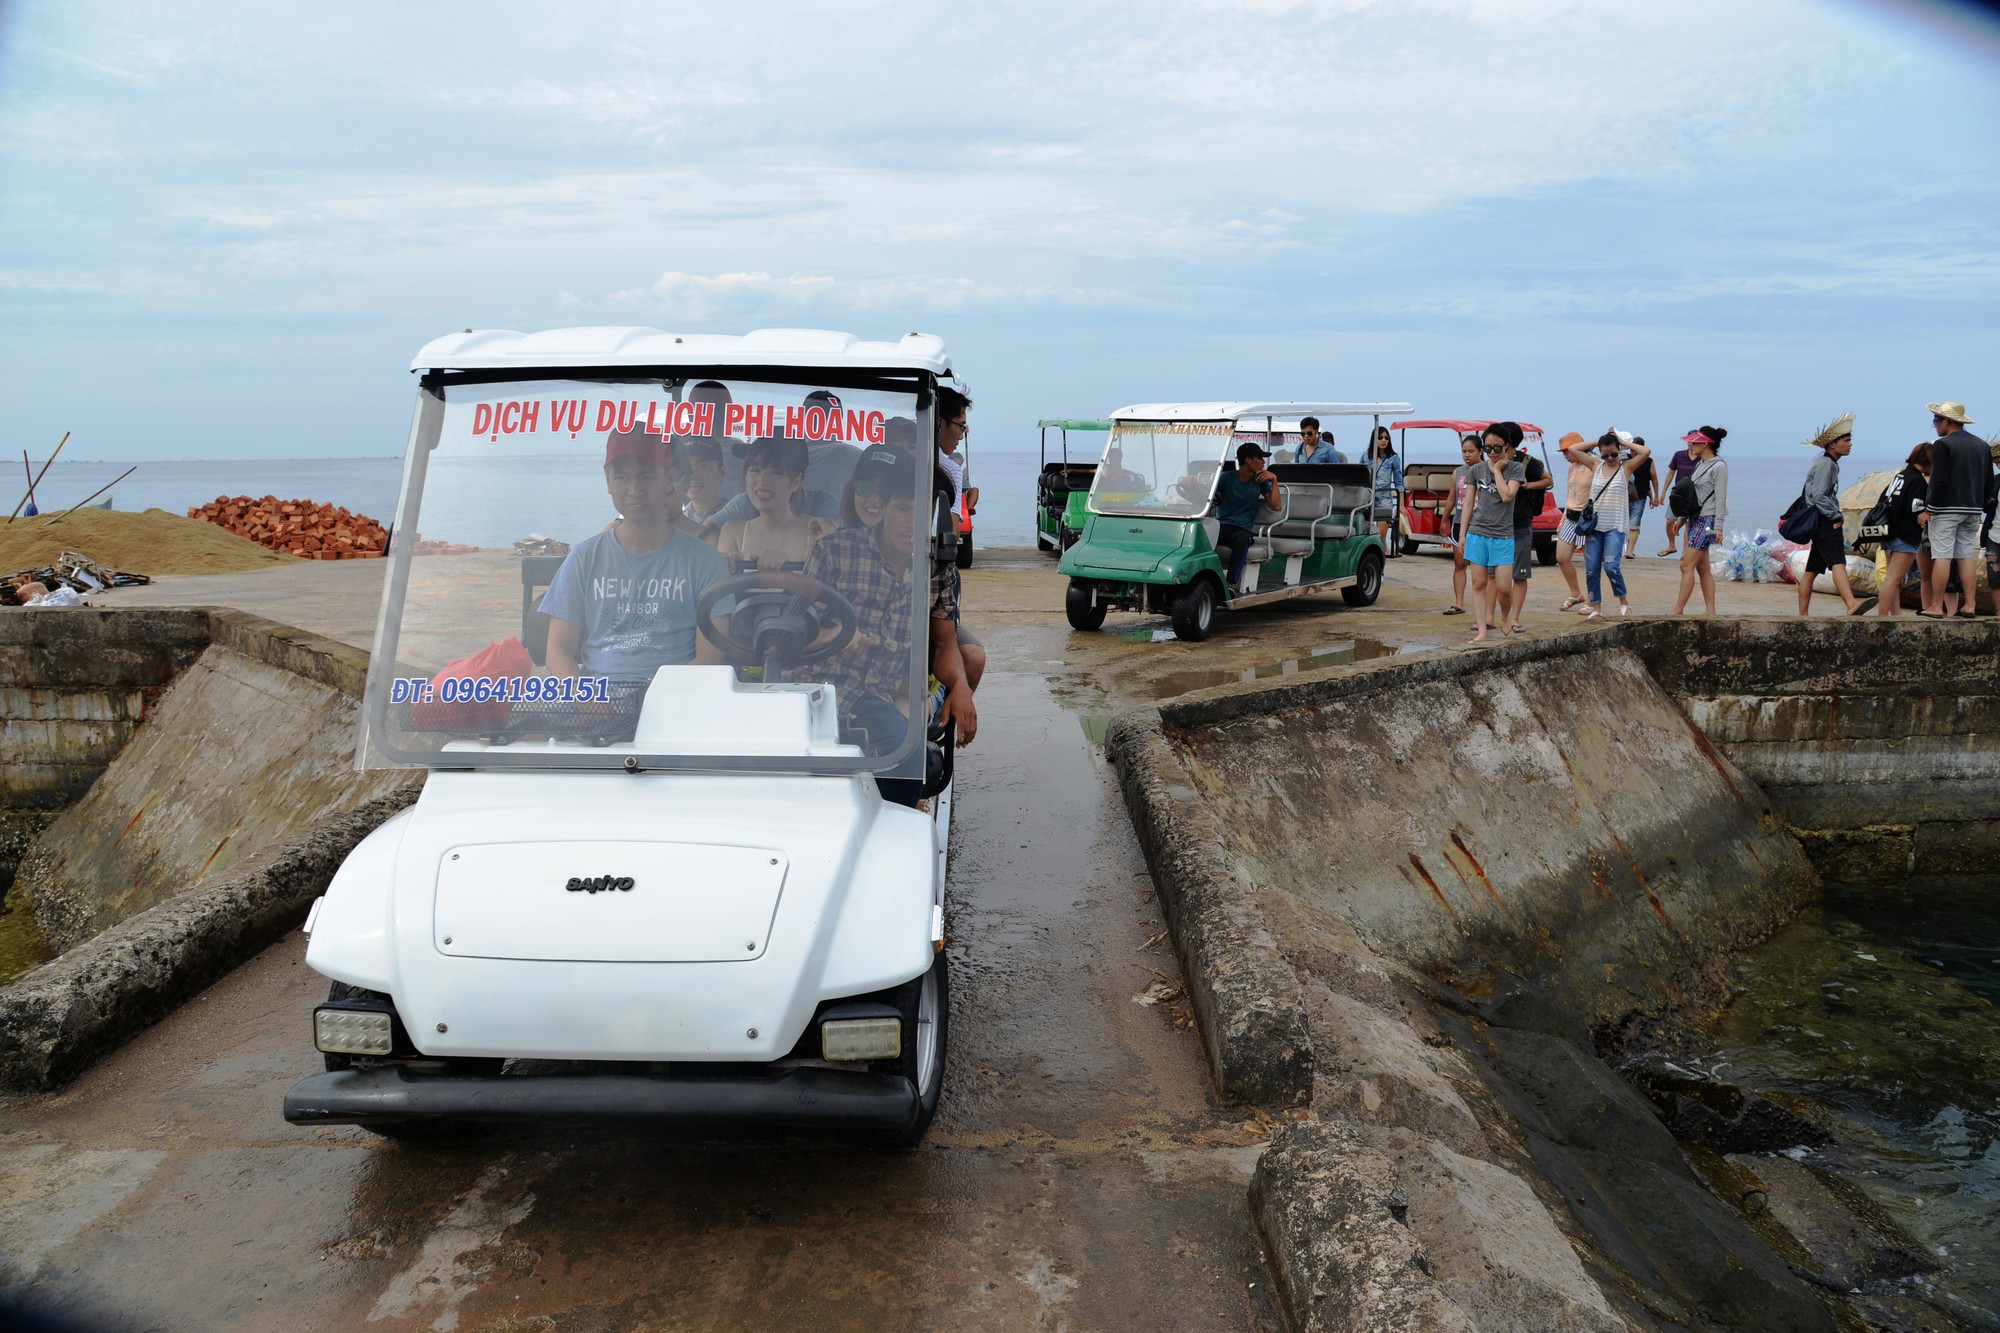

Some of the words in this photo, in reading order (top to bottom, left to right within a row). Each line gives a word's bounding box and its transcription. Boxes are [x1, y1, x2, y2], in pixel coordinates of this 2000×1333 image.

[471, 400, 541, 443] DỊCH
[549, 399, 588, 440] VỤ
[594, 399, 638, 434] DU
[644, 400, 716, 443] LỊCH
[723, 402, 774, 438] PHI
[784, 397, 886, 445] HOÀNG
[593, 577, 631, 600] NEW
[637, 577, 687, 602] YORK
[617, 602, 659, 614] HARBOR
[390, 678, 433, 704] ĐT:
[441, 676, 610, 703] 0964198151
[565, 875, 635, 894] SANYO
